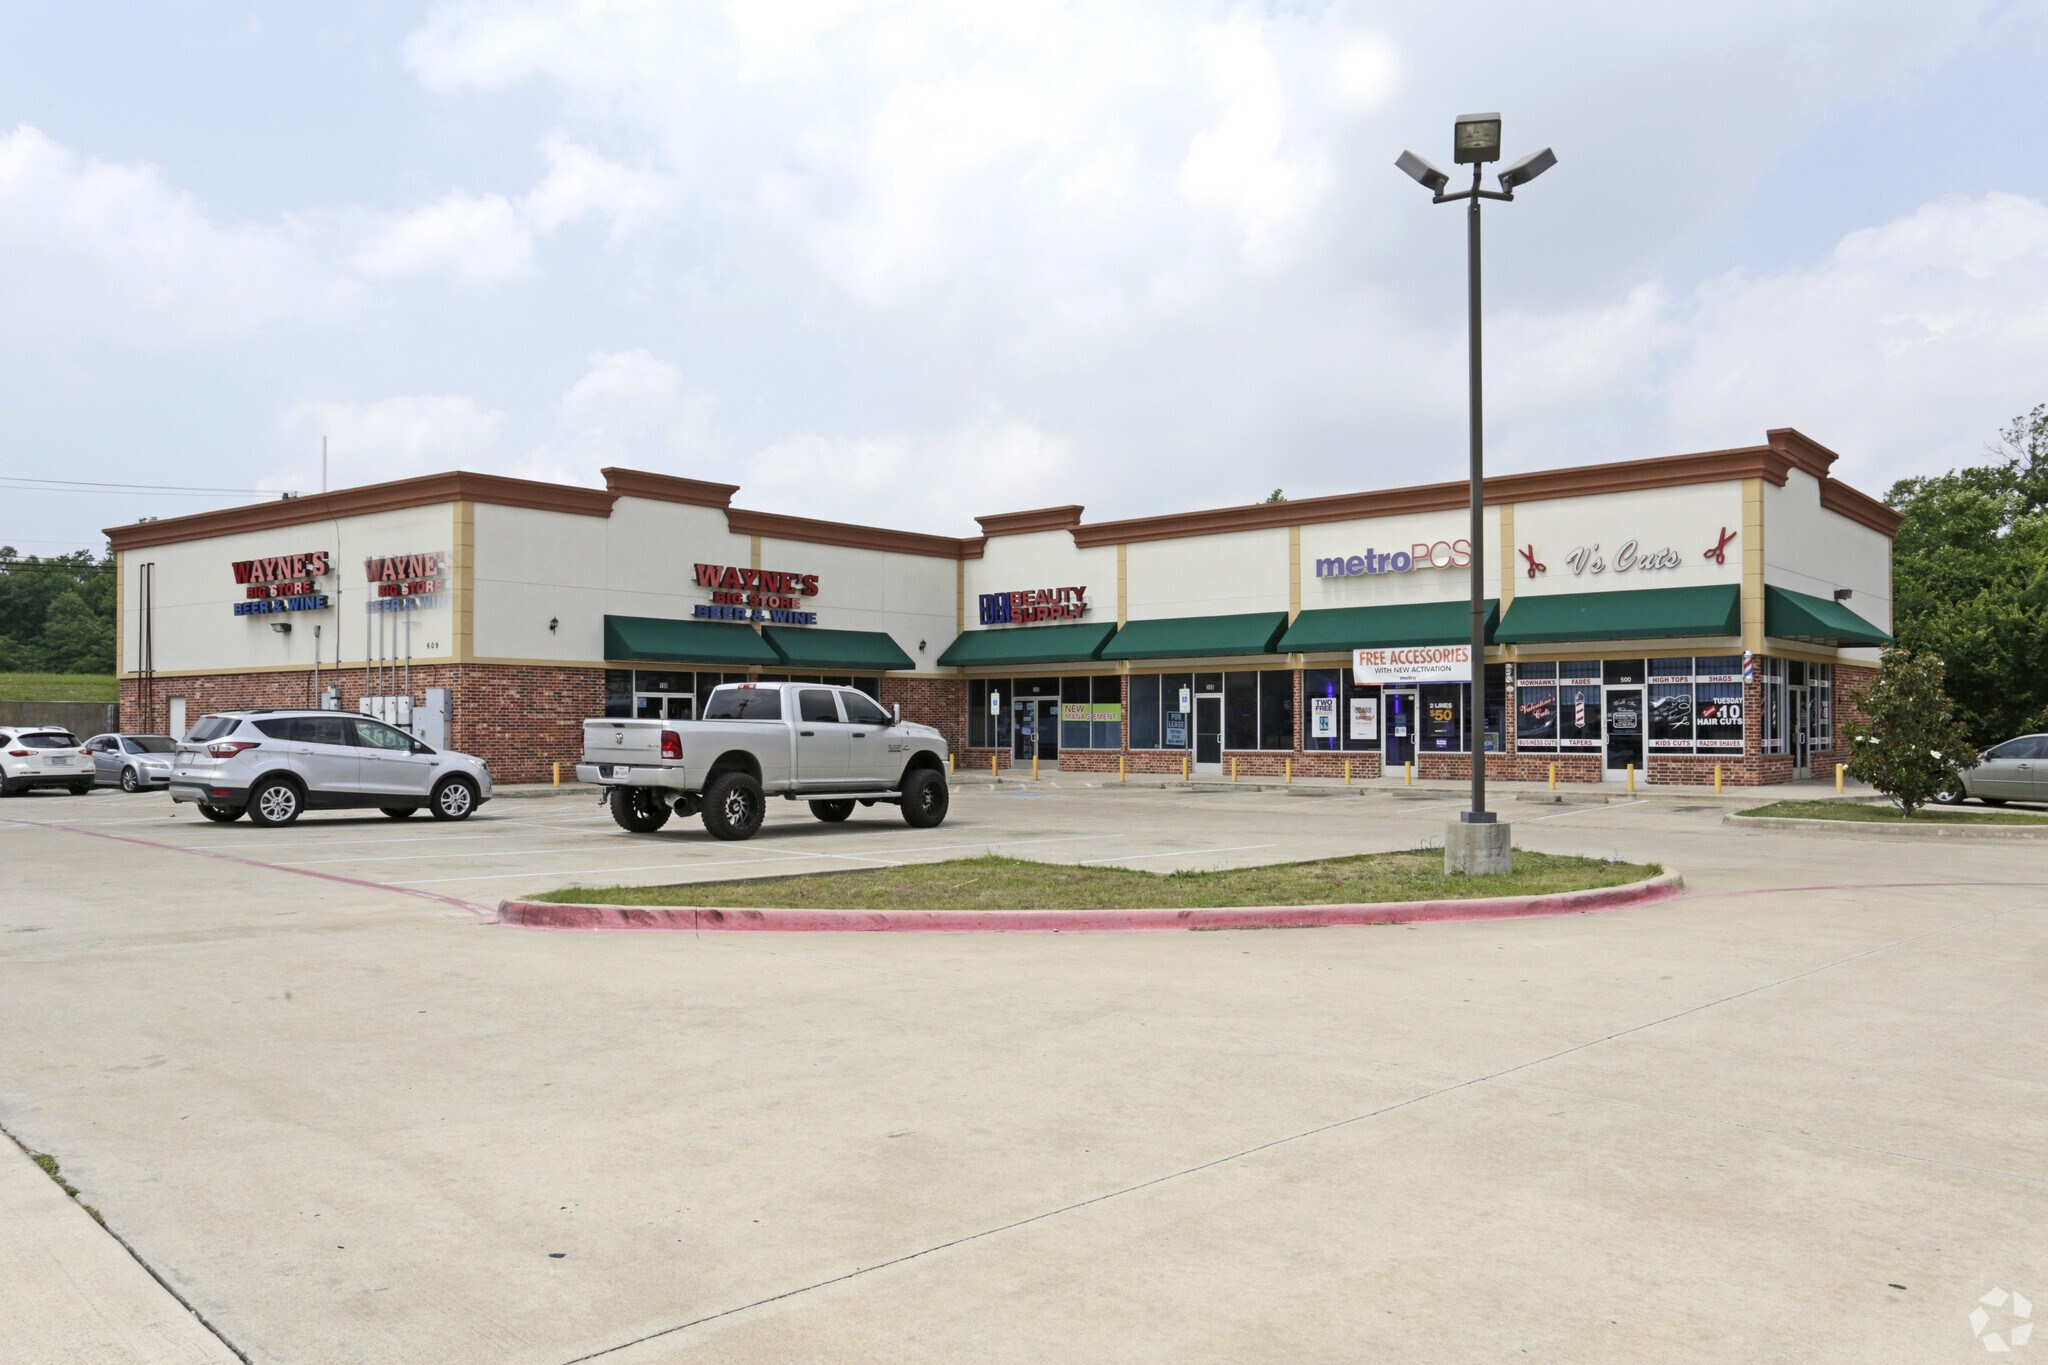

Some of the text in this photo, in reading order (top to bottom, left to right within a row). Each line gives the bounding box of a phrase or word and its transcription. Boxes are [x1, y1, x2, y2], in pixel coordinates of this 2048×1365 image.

[1316, 539, 1472, 578] metroPCS
[1565, 539, 1681, 575] V's Cuts
[232, 551, 329, 584] WAYNE'S
[694, 563, 819, 596] WAYNE'S
[247, 580, 315, 599] BIG STORE
[378, 583, 399, 598] BIG
[1010, 586, 1087, 606] BEAUTY
[234, 595, 329, 616] BEER & WINE
[713, 591, 801, 609] BIG STORE
[694, 604, 817, 625] BEER & WINE
[1010, 602, 1087, 624] SUPPLY
[426, 642, 439, 650] 609
[1360, 647, 1469, 666] FREE ACCESSORIES
[1411, 665, 1452, 673] ACTIVATION
[1064, 704, 1085, 713] NEW
[1713, 697, 1743, 705] TUESDAY
[1064, 712, 1117, 720] MANAGEMENT
[1429, 709, 1453, 721] $50
[1697, 718, 1743, 726] HAIR CUTS
